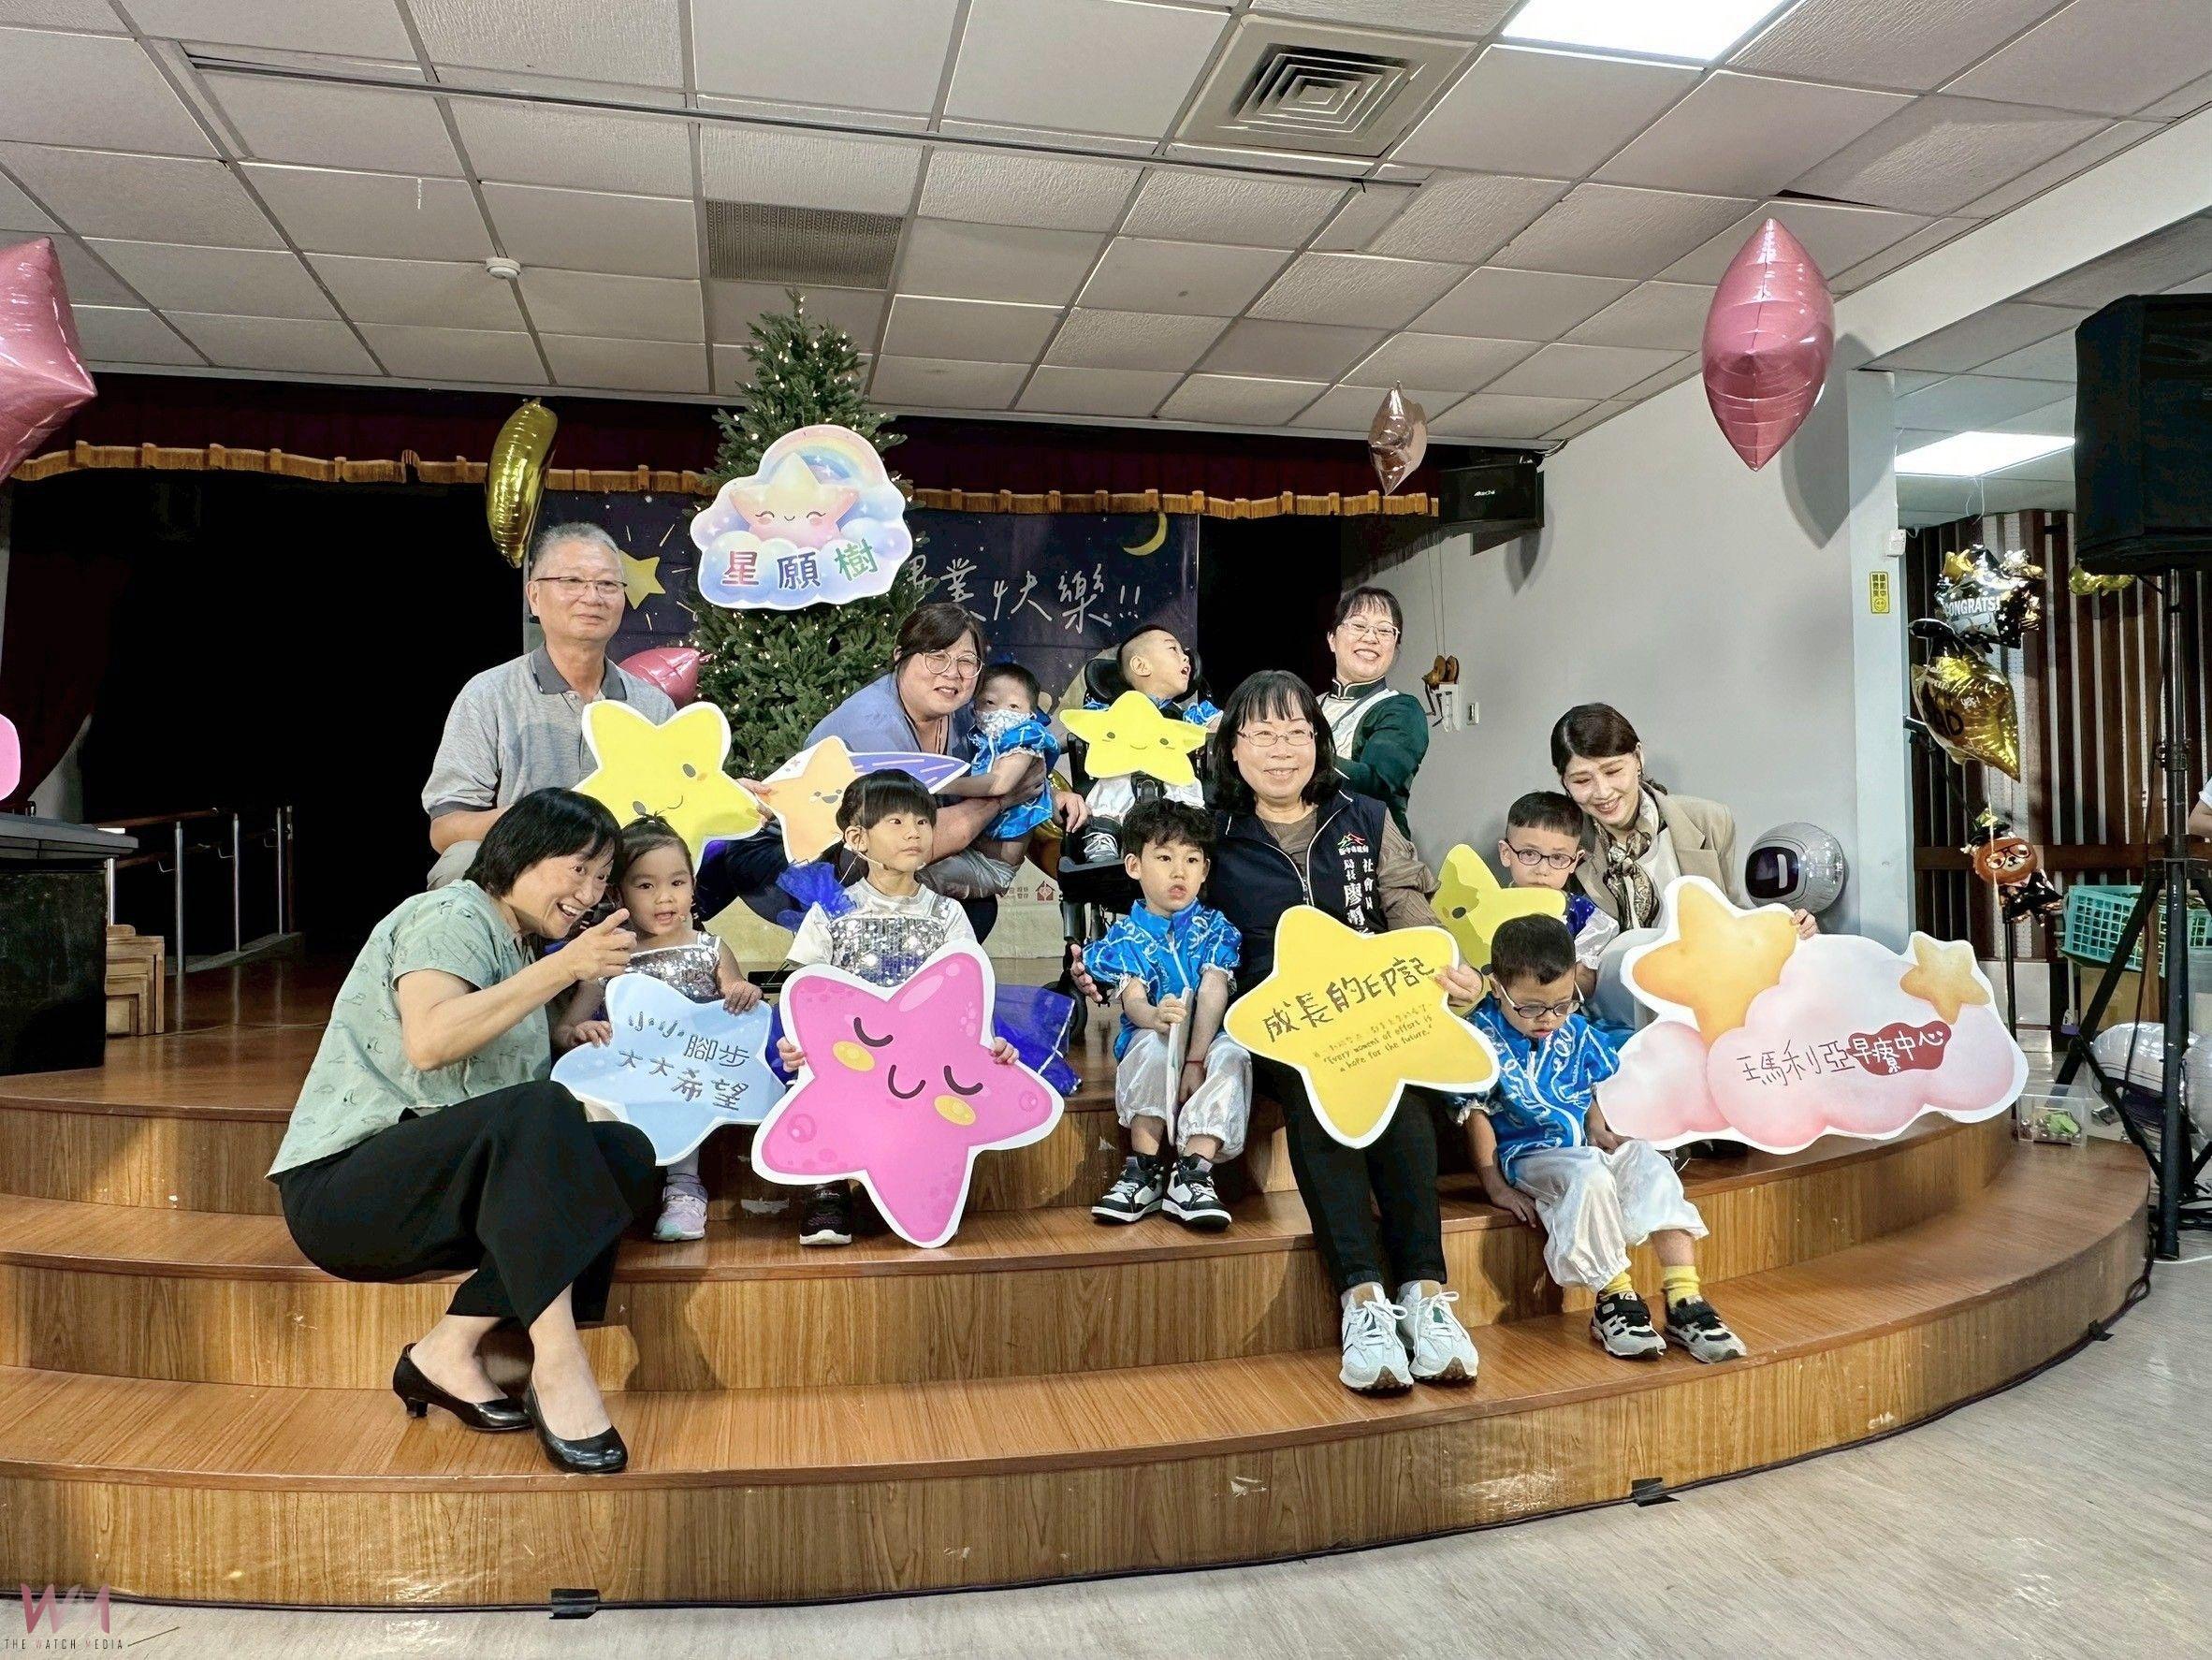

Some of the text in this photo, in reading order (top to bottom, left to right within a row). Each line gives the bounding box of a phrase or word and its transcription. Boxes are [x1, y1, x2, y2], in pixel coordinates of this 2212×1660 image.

[721, 538, 880, 590] 星願樹
[1261, 956, 1435, 1043] 成長的印記
[628, 1011, 750, 1068] 小小腳步
[1368, 1049, 1382, 1059] for
[1384, 1042, 1400, 1052] the
[1382, 1030, 1392, 1041] of
[1394, 1019, 1420, 1035] effort
[1424, 1014, 1433, 1024] is
[618, 1048, 749, 1112] 大大希望
